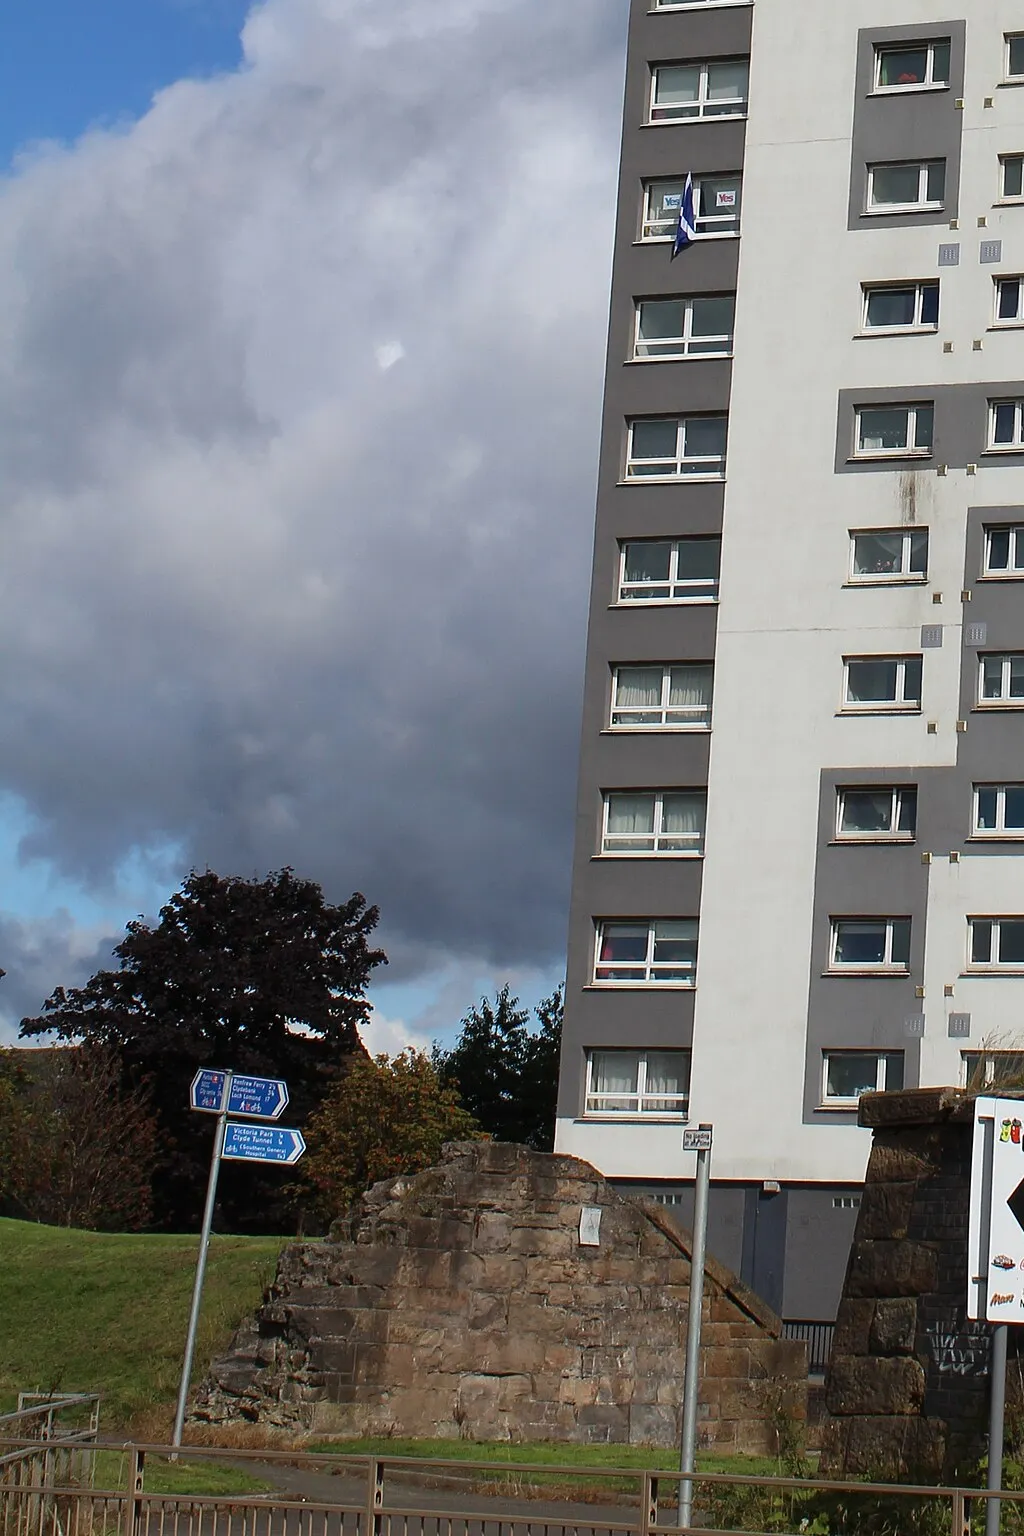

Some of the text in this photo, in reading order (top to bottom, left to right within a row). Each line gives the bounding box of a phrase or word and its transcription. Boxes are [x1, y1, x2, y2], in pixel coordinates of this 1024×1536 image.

[665, 197, 680, 206] Yes
[719, 194, 734, 202] Yes
[233, 1078, 253, 1087] Renfrew
[254, 1081, 266, 1090] Ferry
[232, 1085, 256, 1094] Clydebank
[233, 1127, 258, 1136] Victoria
[233, 1134, 250, 1143] Clyde
[252, 1136, 273, 1144] Tunnel
[990, 1293, 1015, 1307] Mars
